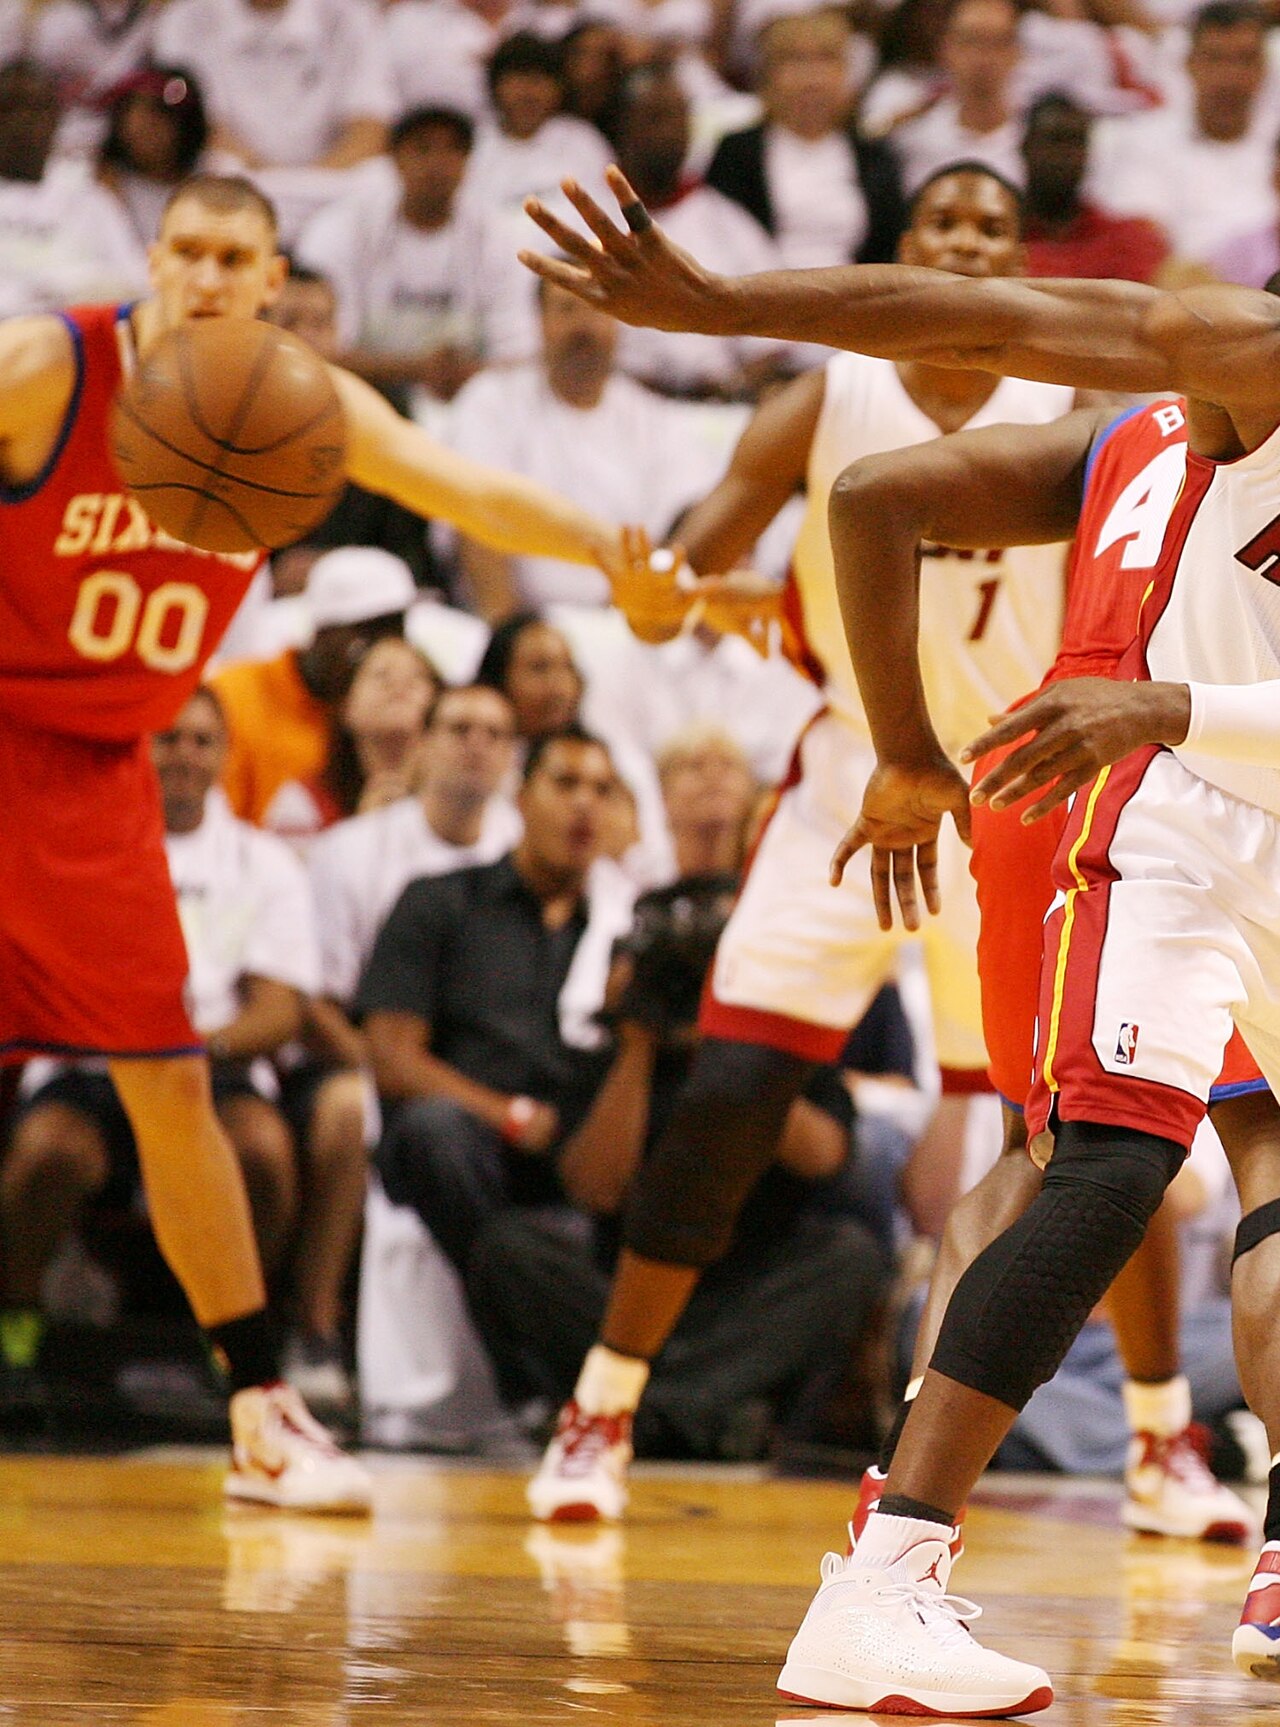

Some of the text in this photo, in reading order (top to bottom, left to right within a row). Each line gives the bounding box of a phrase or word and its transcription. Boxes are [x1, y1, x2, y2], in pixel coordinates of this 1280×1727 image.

[54, 493, 260, 570] SIX
[67, 570, 209, 675] 00
[968, 579, 999, 640] 1
